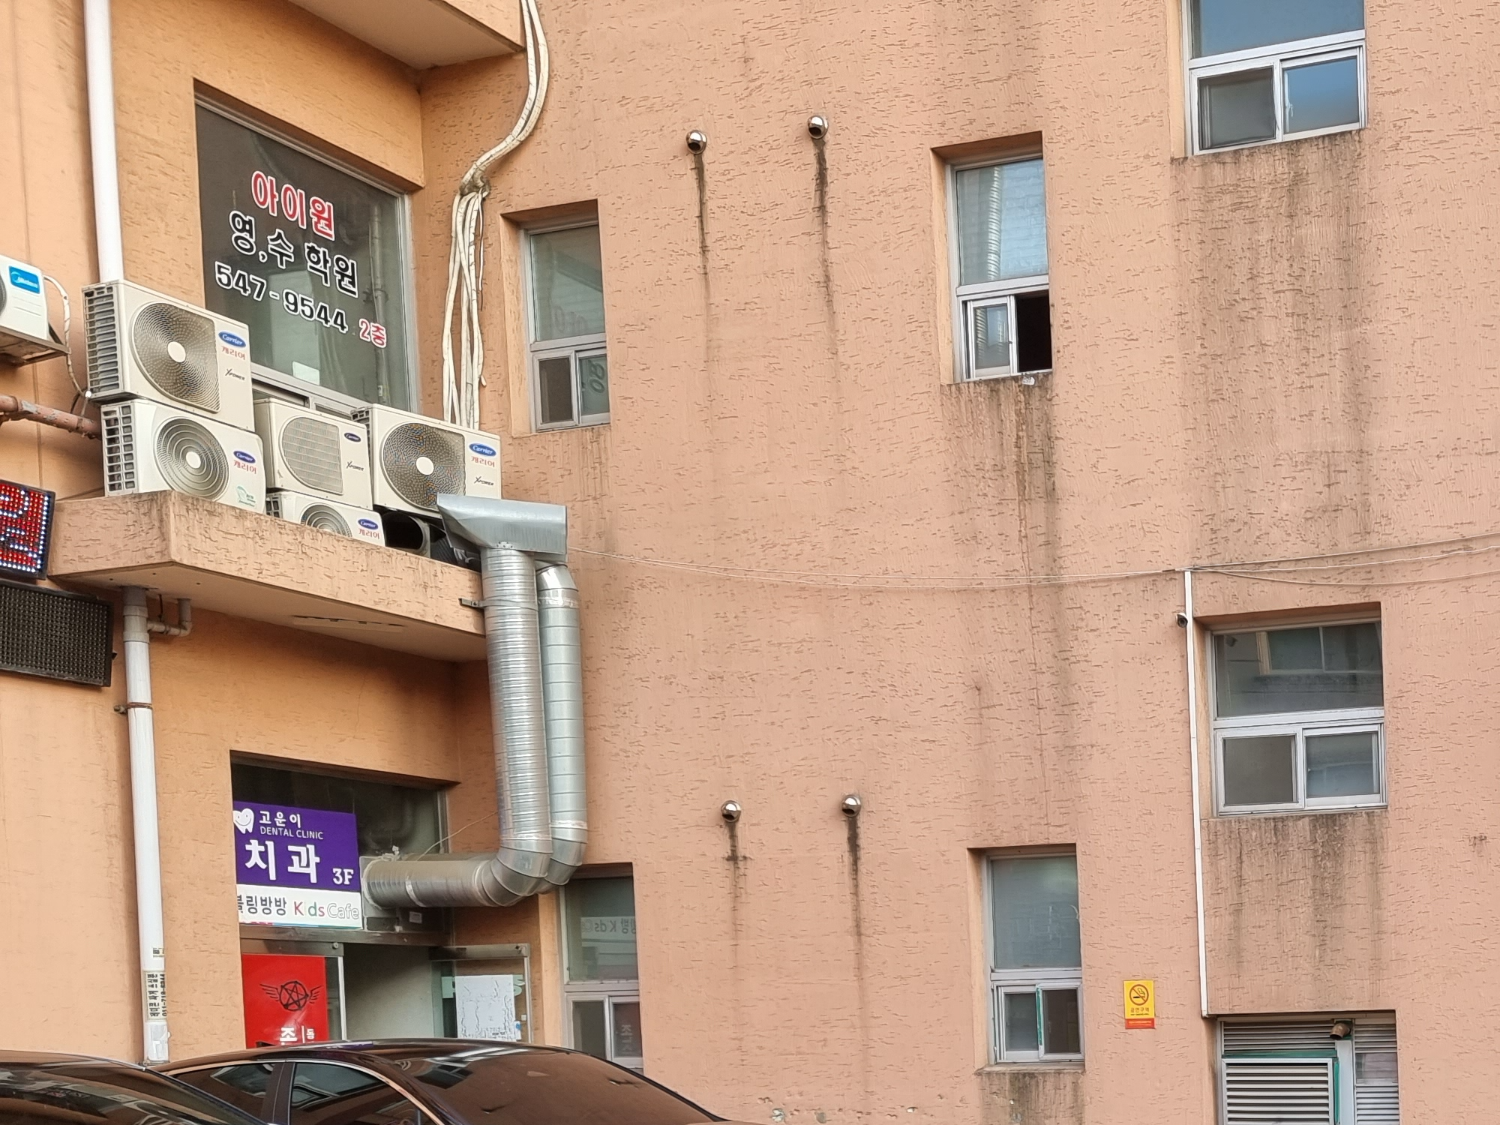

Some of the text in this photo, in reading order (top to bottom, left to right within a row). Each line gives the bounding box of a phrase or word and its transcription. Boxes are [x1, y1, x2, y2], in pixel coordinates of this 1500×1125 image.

[252, 171, 335, 241] 아이원
[304, 243, 358, 298] 학원
[359, 318, 387, 348] 2층
[259, 810, 302, 828] 고운이
[260, 826, 324, 840] DENTAL CLINIC
[244, 839, 320, 884] 치과
[332, 868, 354, 885] 3F
